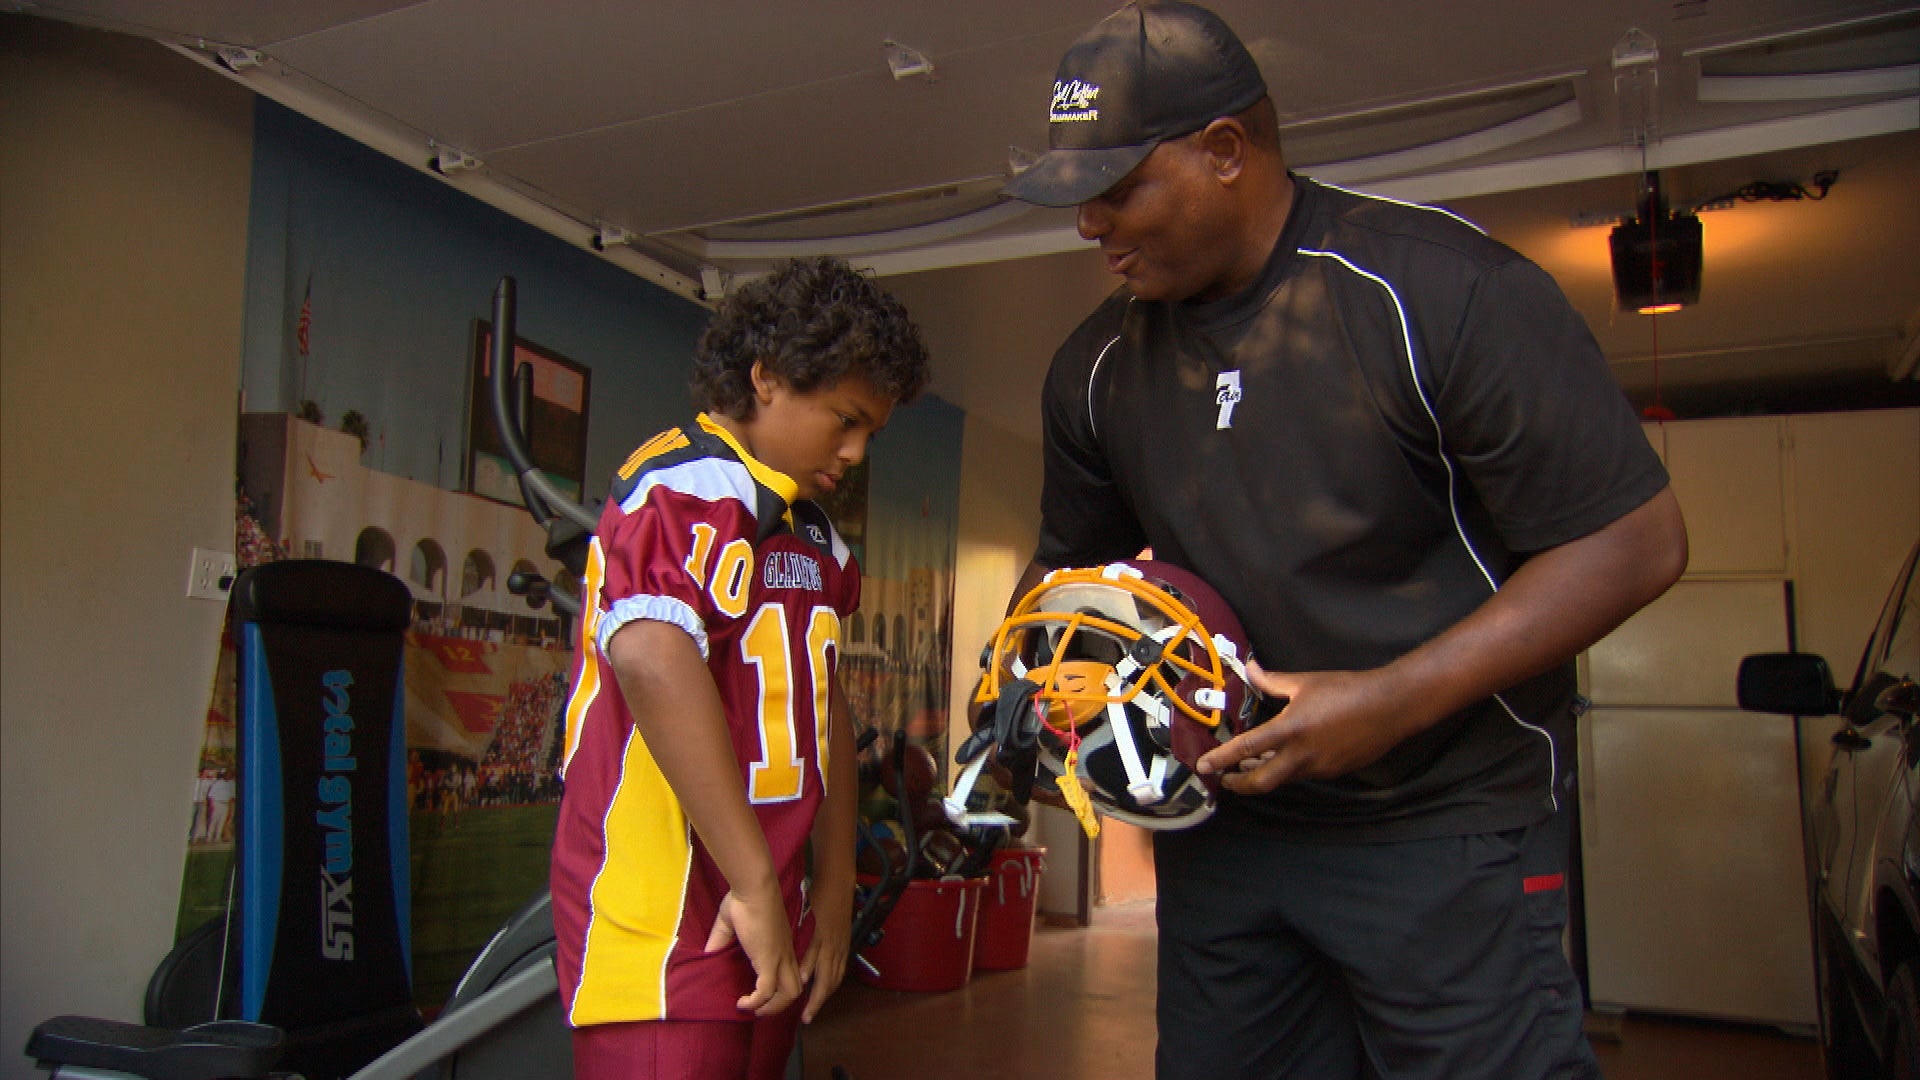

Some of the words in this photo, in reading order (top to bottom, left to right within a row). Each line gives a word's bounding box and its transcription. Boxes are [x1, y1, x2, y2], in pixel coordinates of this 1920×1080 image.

[684, 522, 756, 618] 10
[321, 669, 358, 771] total
[315, 775, 355, 874] gym
[319, 863, 355, 961] XLS
